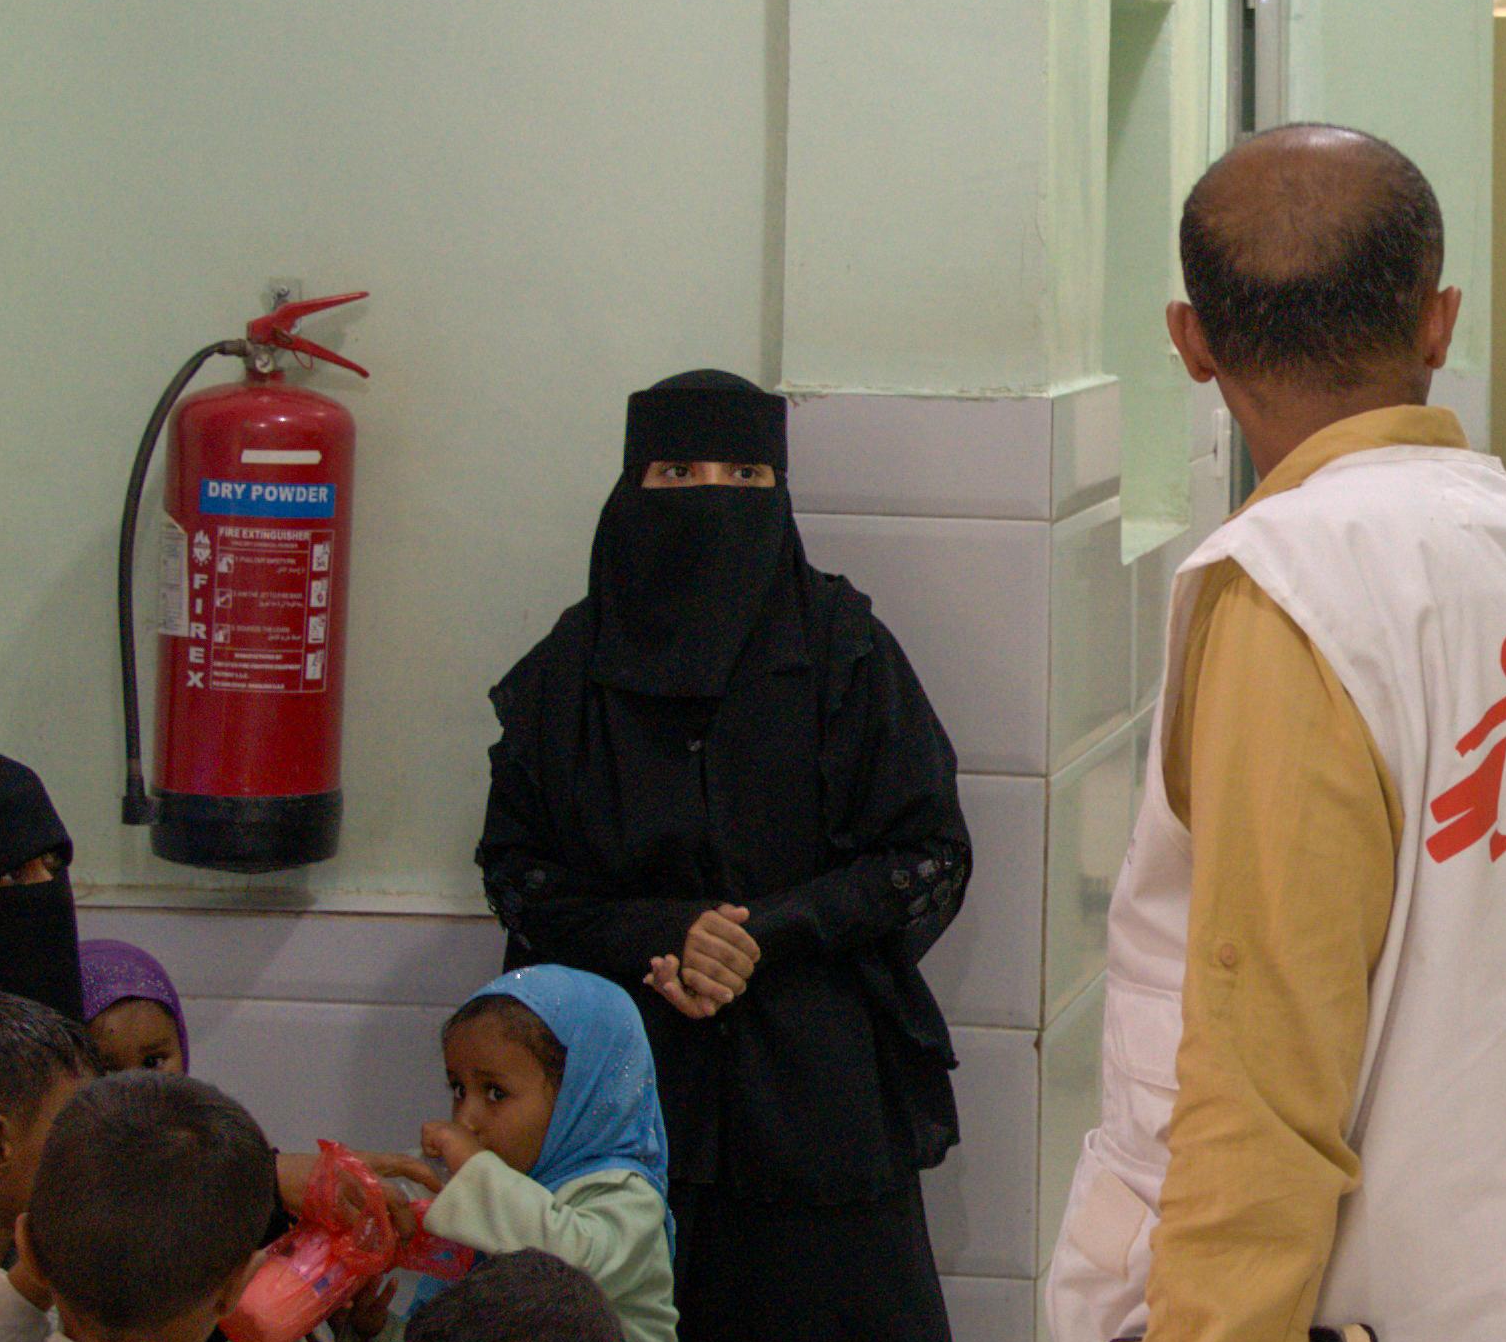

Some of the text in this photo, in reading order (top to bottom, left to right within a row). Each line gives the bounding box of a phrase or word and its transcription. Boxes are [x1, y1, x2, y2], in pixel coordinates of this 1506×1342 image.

[207, 481, 328, 503] DRY POWDER
[218, 527, 310, 541] FIRE EXTINGUISHER
